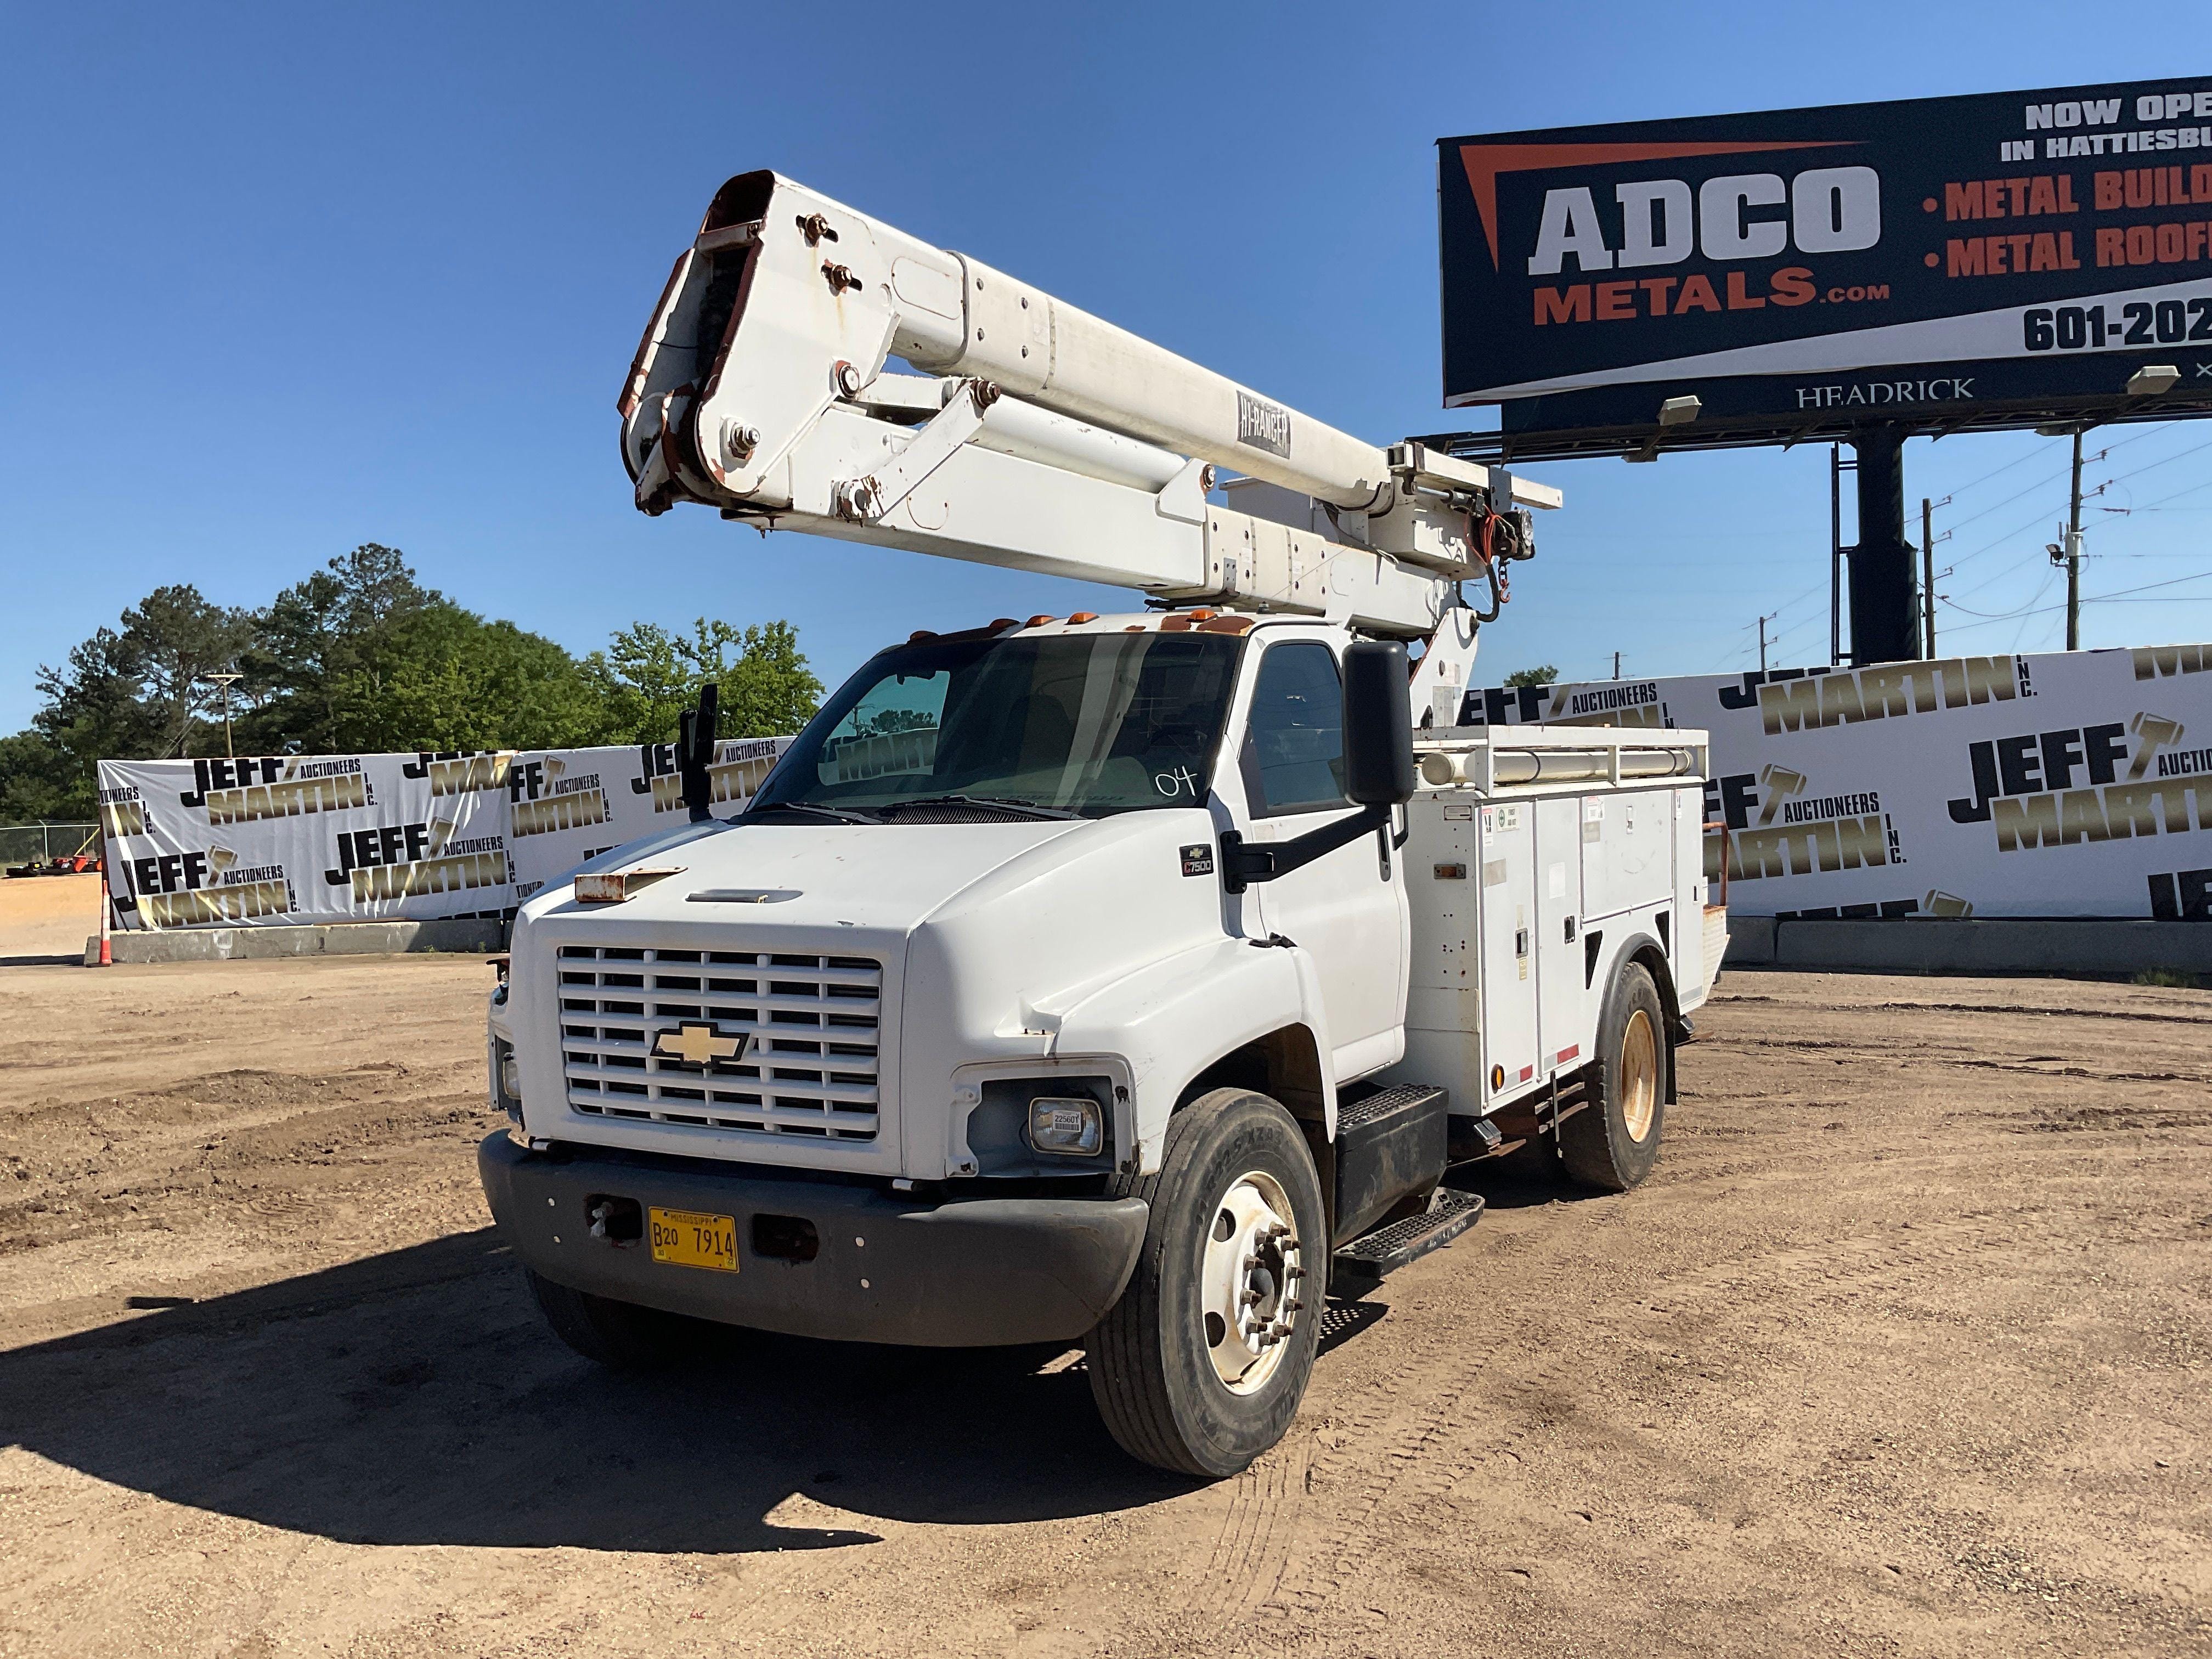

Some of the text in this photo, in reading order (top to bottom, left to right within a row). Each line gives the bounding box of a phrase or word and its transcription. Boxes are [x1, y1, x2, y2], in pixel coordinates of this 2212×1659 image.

[2025, 98, 2121, 130] NOW
[2001, 140, 2034, 162] IN
[1945, 174, 2079, 222] METAL
[1528, 166, 1881, 275] ADCO
[1948, 231, 2081, 278] METAL
[1240, 395, 1288, 455] HI-RANGER
[1571, 682, 1658, 715] AUCTIONEERS
[1759, 654, 2017, 736] MARTIN
[725, 740, 777, 763] AUCTIONEERS
[300, 758, 362, 780] AUCTIONEERS
[555, 773, 600, 795] AUCTIONEERS
[1155, 765, 1198, 797] 04
[1947, 722, 2129, 824] JEFF
[207, 774, 365, 826] MARTIN
[364, 772, 378, 806] INC.
[601, 788, 613, 822] INC.
[142, 800, 156, 834] INC.
[1784, 791, 1880, 823] AUCTIONEERS
[324, 822, 430, 886] JEFF
[444, 836, 504, 857] AUCTIONEERS
[1885, 813, 1908, 864] INC.
[111, 851, 208, 913] JEFF
[223, 865, 284, 885] AUCTIONEERS
[351, 851, 507, 904] MARTIN
[1184, 860, 1211, 874] C7500
[136, 880, 288, 928] MARTIN
[287, 879, 301, 912] INC.
[670, 1214, 712, 1227] MISSISSIPPI
[652, 1222, 734, 1257] B20 7914
